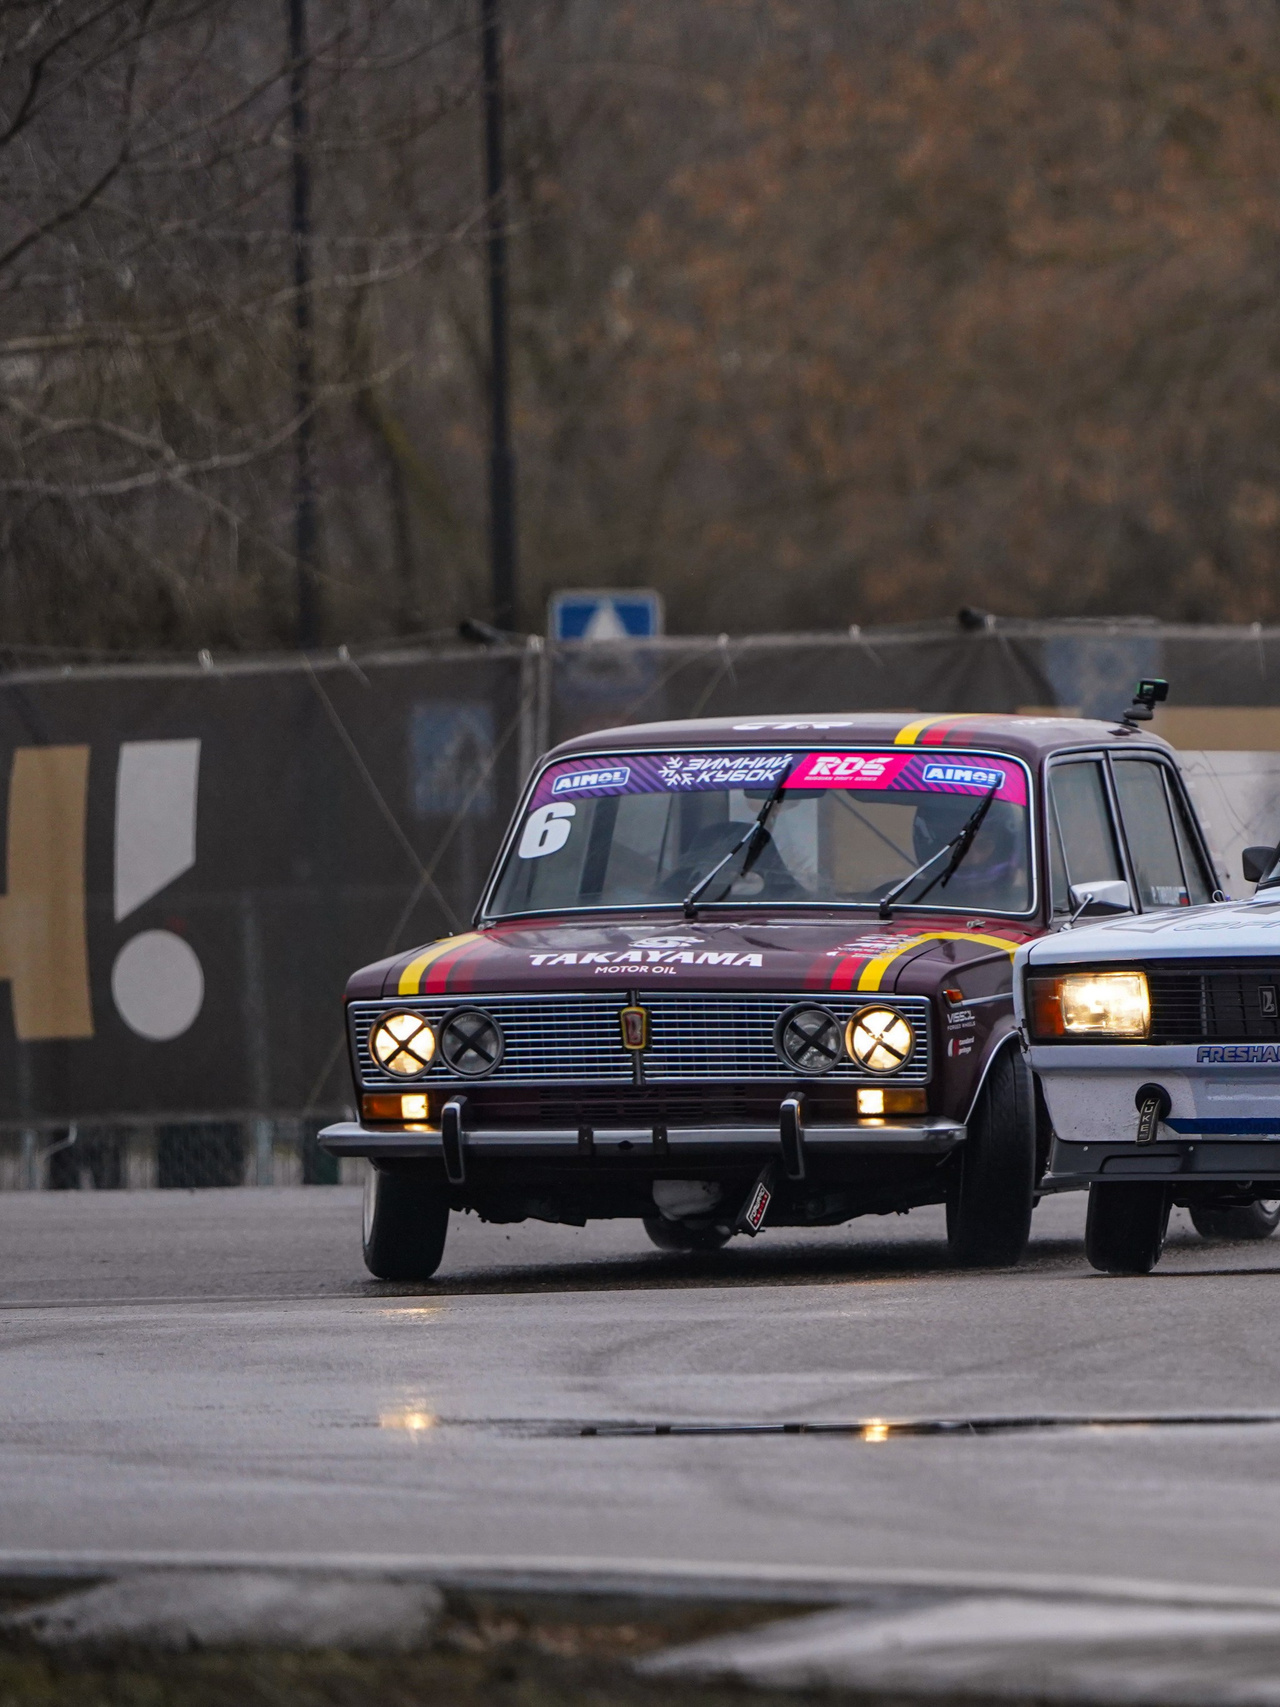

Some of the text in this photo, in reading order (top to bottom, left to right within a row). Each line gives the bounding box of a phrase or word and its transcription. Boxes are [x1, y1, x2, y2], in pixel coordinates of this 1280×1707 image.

[682, 753, 793, 771] ЗИМНИЙ
[808, 756, 894, 776] RDS
[556, 771, 625, 791] AIMOL
[696, 769, 783, 782] КУБОК
[926, 767, 999, 784] AIMOL
[518, 801, 576, 858] 6
[529, 950, 763, 967] TAKAYAMA
[594, 965, 677, 974] MOTOR OIL
